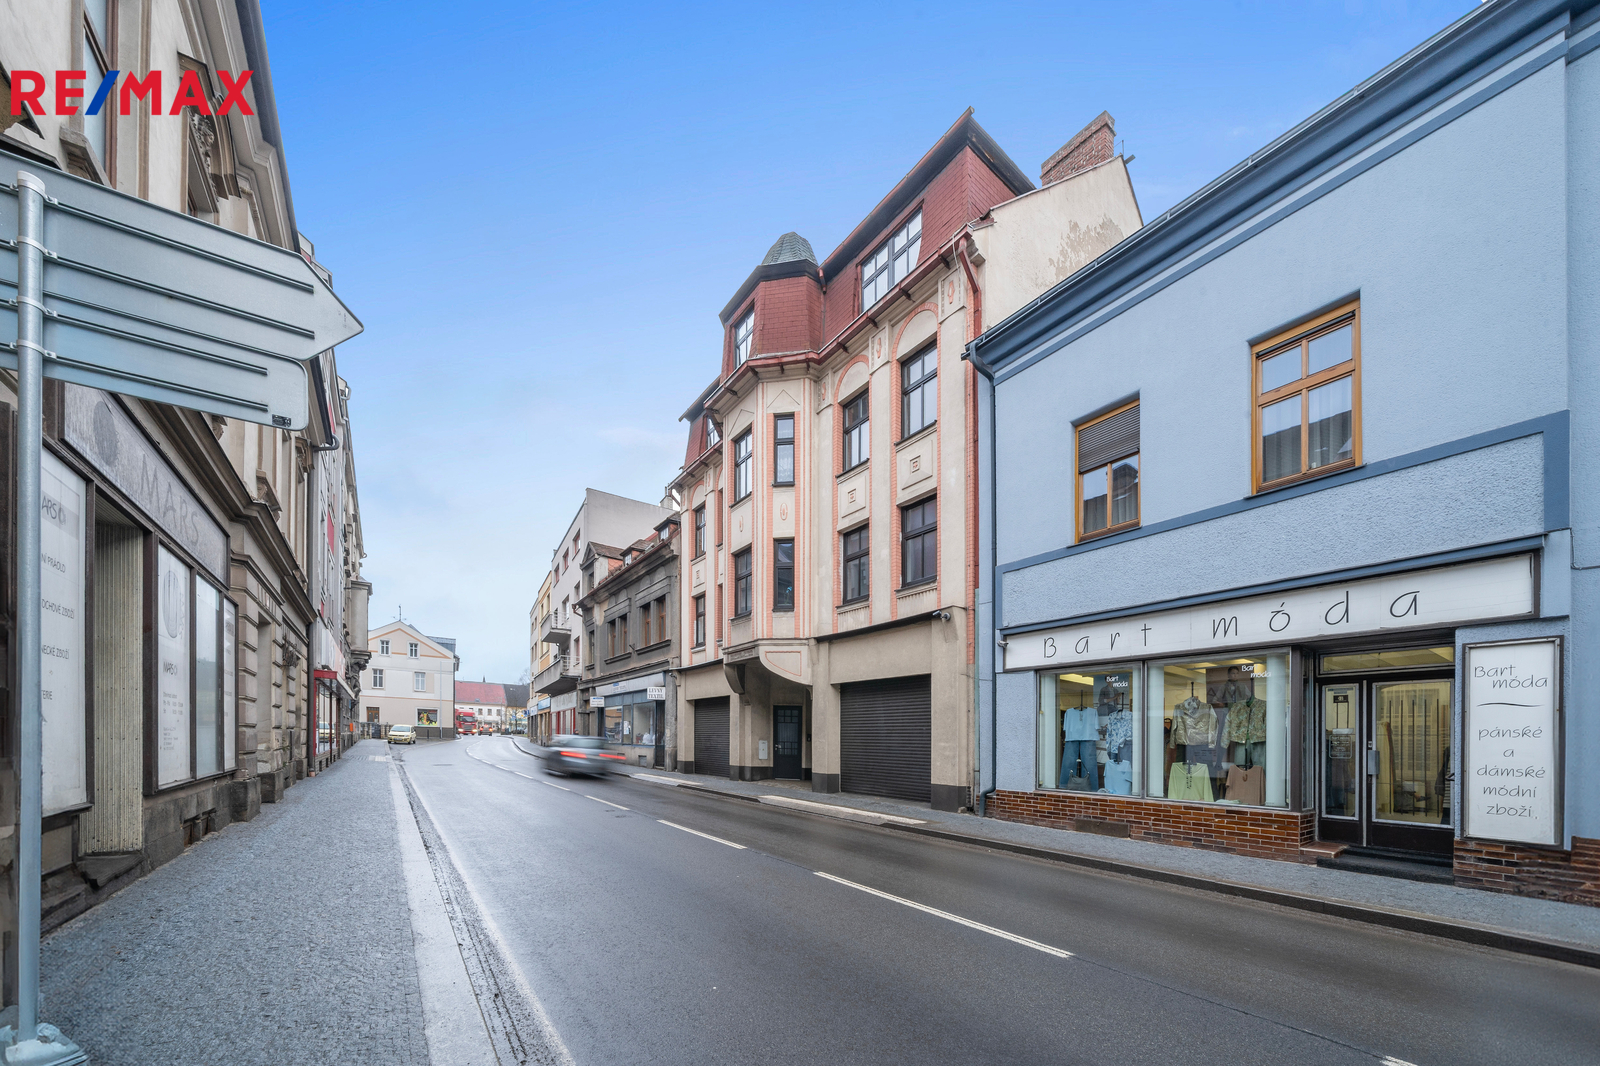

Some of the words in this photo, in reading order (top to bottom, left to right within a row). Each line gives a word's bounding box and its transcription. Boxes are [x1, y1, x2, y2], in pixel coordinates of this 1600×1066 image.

[139, 453, 199, 547] MARS
[41, 495, 58, 520] ARS
[41, 598, 61, 615] OCHOVÉ
[1043, 623, 1152, 658] Bart
[1212, 590, 1420, 639] móda
[1241, 664, 1258, 672] Bart
[1250, 670, 1272, 678] móda
[1474, 664, 1516, 678] Bart
[1106, 675, 1119, 683] Bart
[1112, 680, 1129, 688] móda
[1492, 675, 1548, 689] móda
[1478, 726, 1543, 741] pánské
[1502, 748, 1515, 758] a
[1476, 764, 1546, 779] dámské
[1483, 785, 1537, 798] módní
